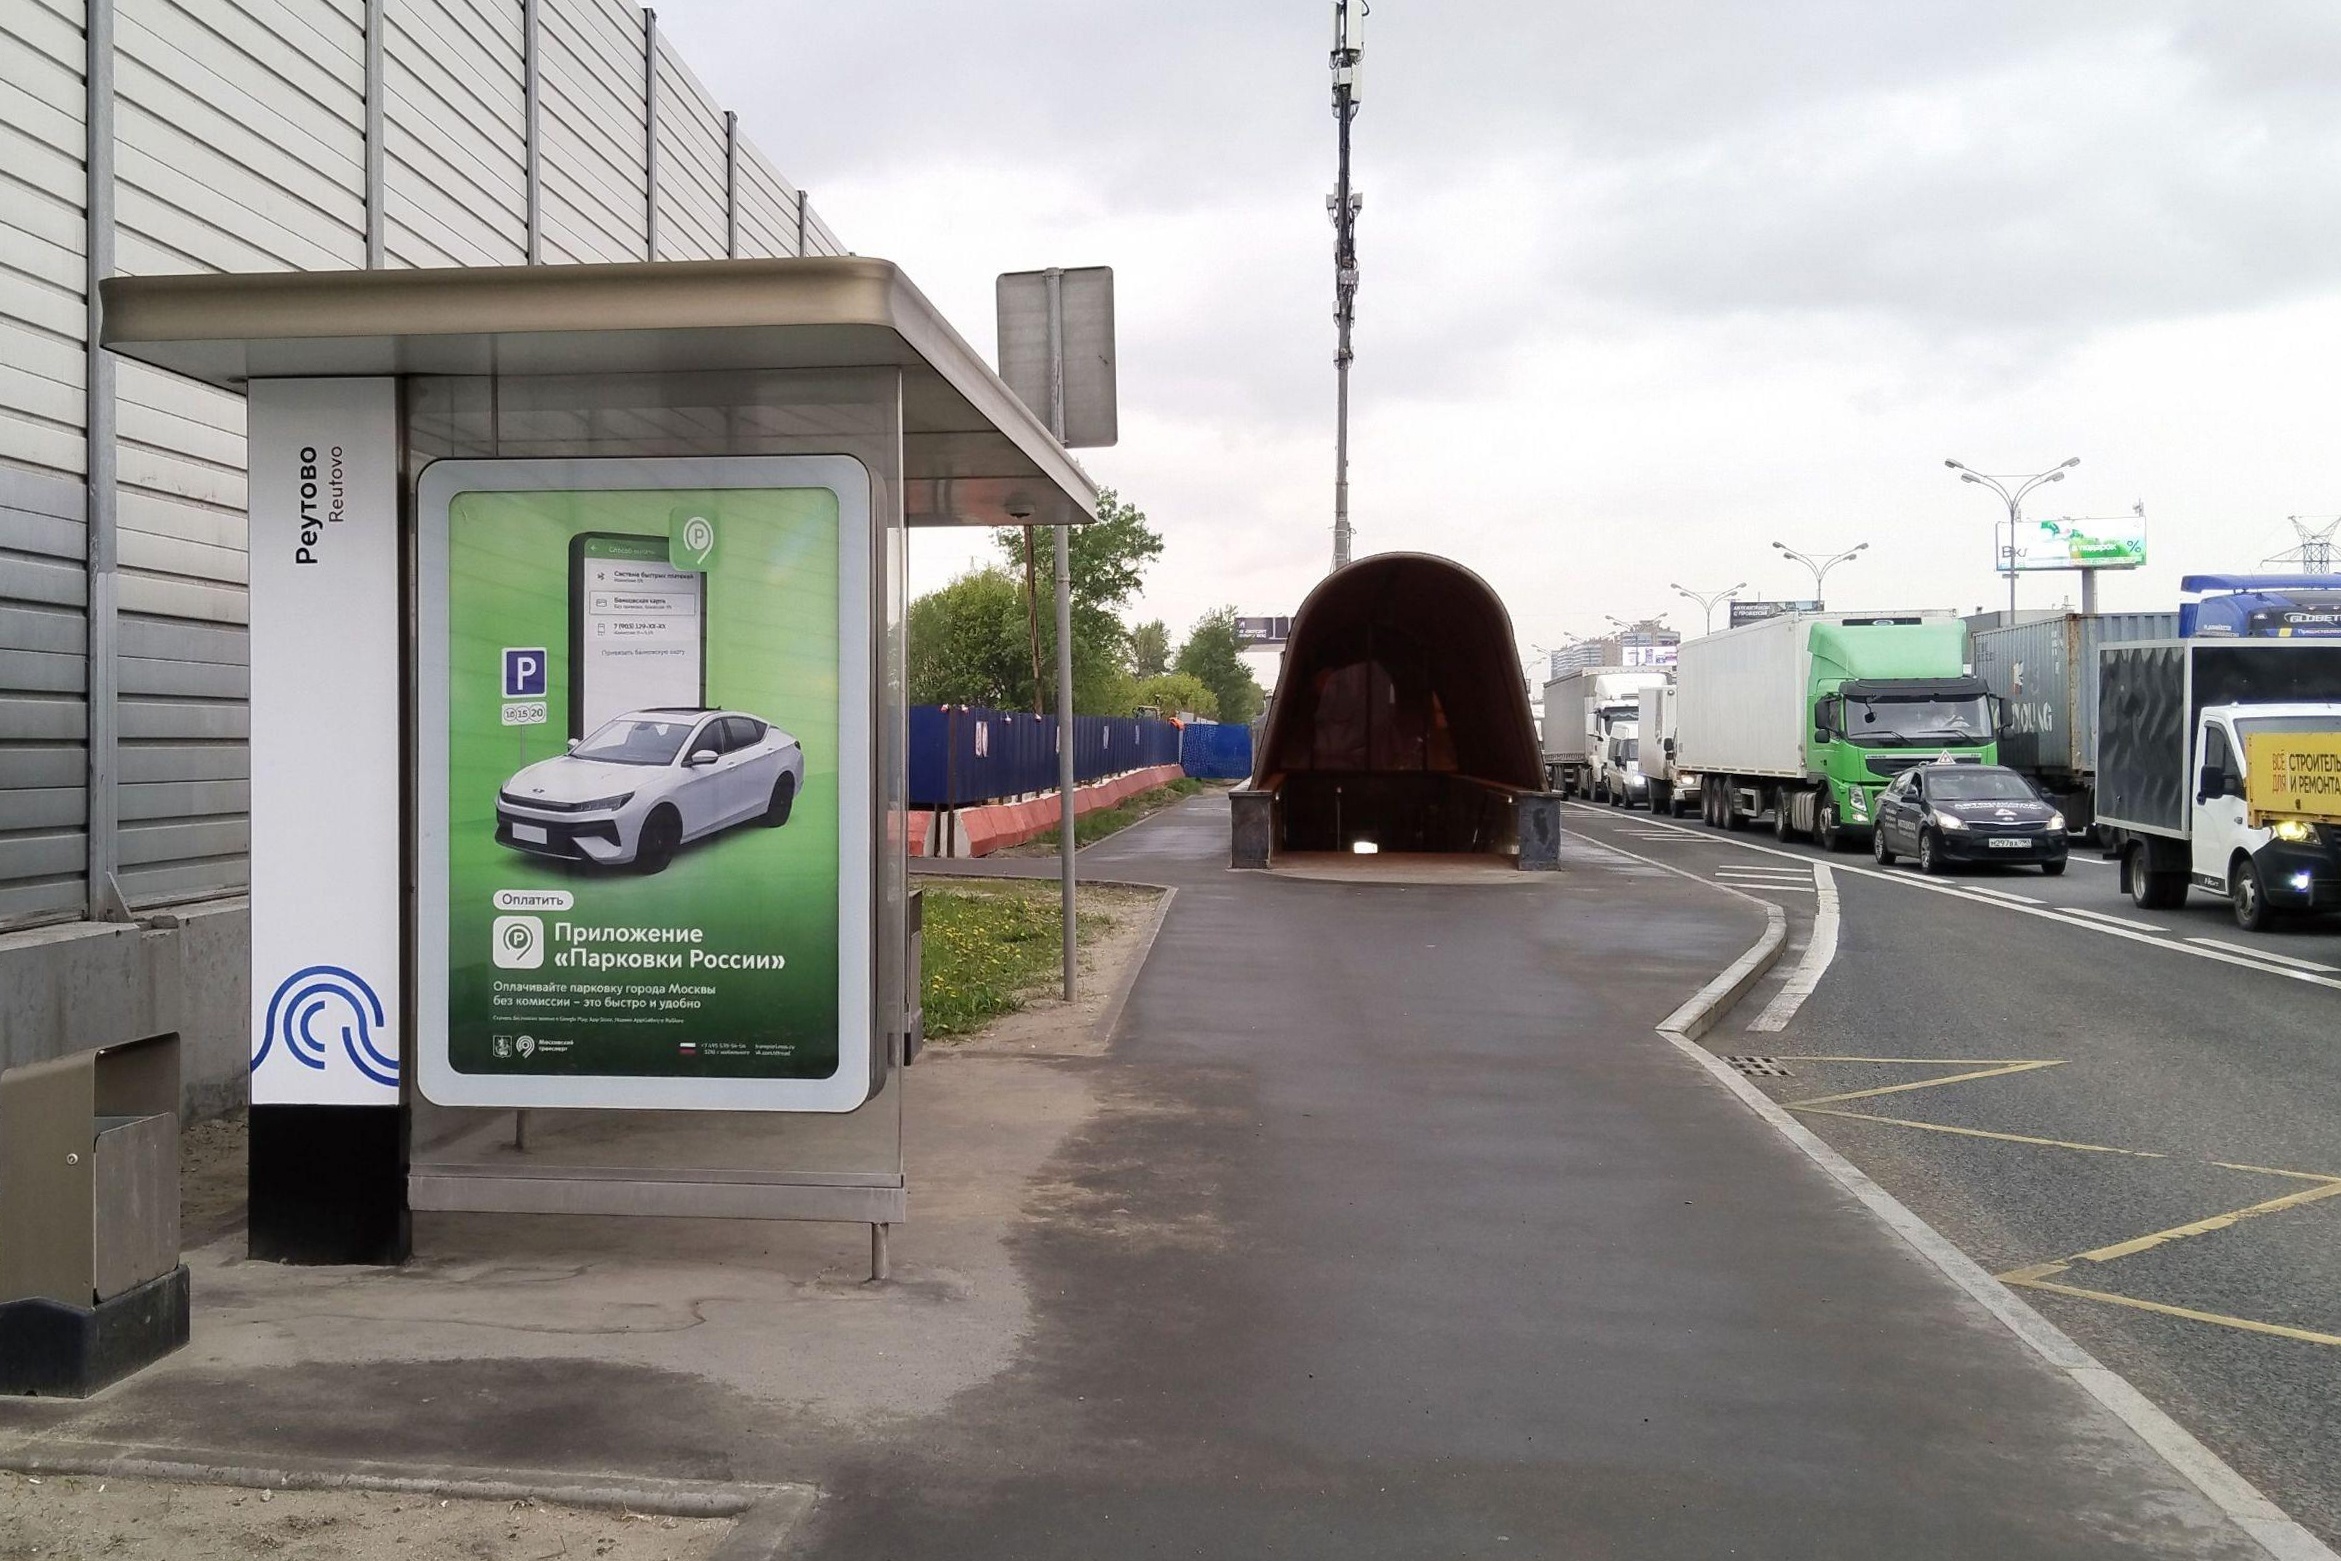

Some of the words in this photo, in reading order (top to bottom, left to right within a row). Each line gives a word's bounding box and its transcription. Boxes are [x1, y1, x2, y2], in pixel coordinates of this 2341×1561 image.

[329, 446, 344, 522] Reutovo
[296, 446, 323, 564] Реутово
[2288, 613, 2341, 623] GLOBET
[517, 656, 537, 690] P
[531, 708, 544, 718] 20
[2272, 774, 2286, 794] ДЛЯ
[2290, 775, 2297, 793] И
[2299, 775, 2341, 795] РЕМОНТА
[502, 894, 564, 906] Оплатить
[554, 922, 703, 943] Приложение
[554, 948, 682, 972] «Парковки
[689, 949, 786, 970] России»
[493, 981, 567, 994] Оплачивайте
[569, 984, 623, 996] парковку
[626, 985, 665, 996] города
[668, 984, 717, 996] Москвы
[493, 995, 513, 1007] без
[516, 998, 571, 1008] комиссии
[583, 998, 602, 1008] это
[604, 996, 647, 1010] быстро
[650, 999, 657, 1008] и
[658, 998, 702, 1011] удобно
